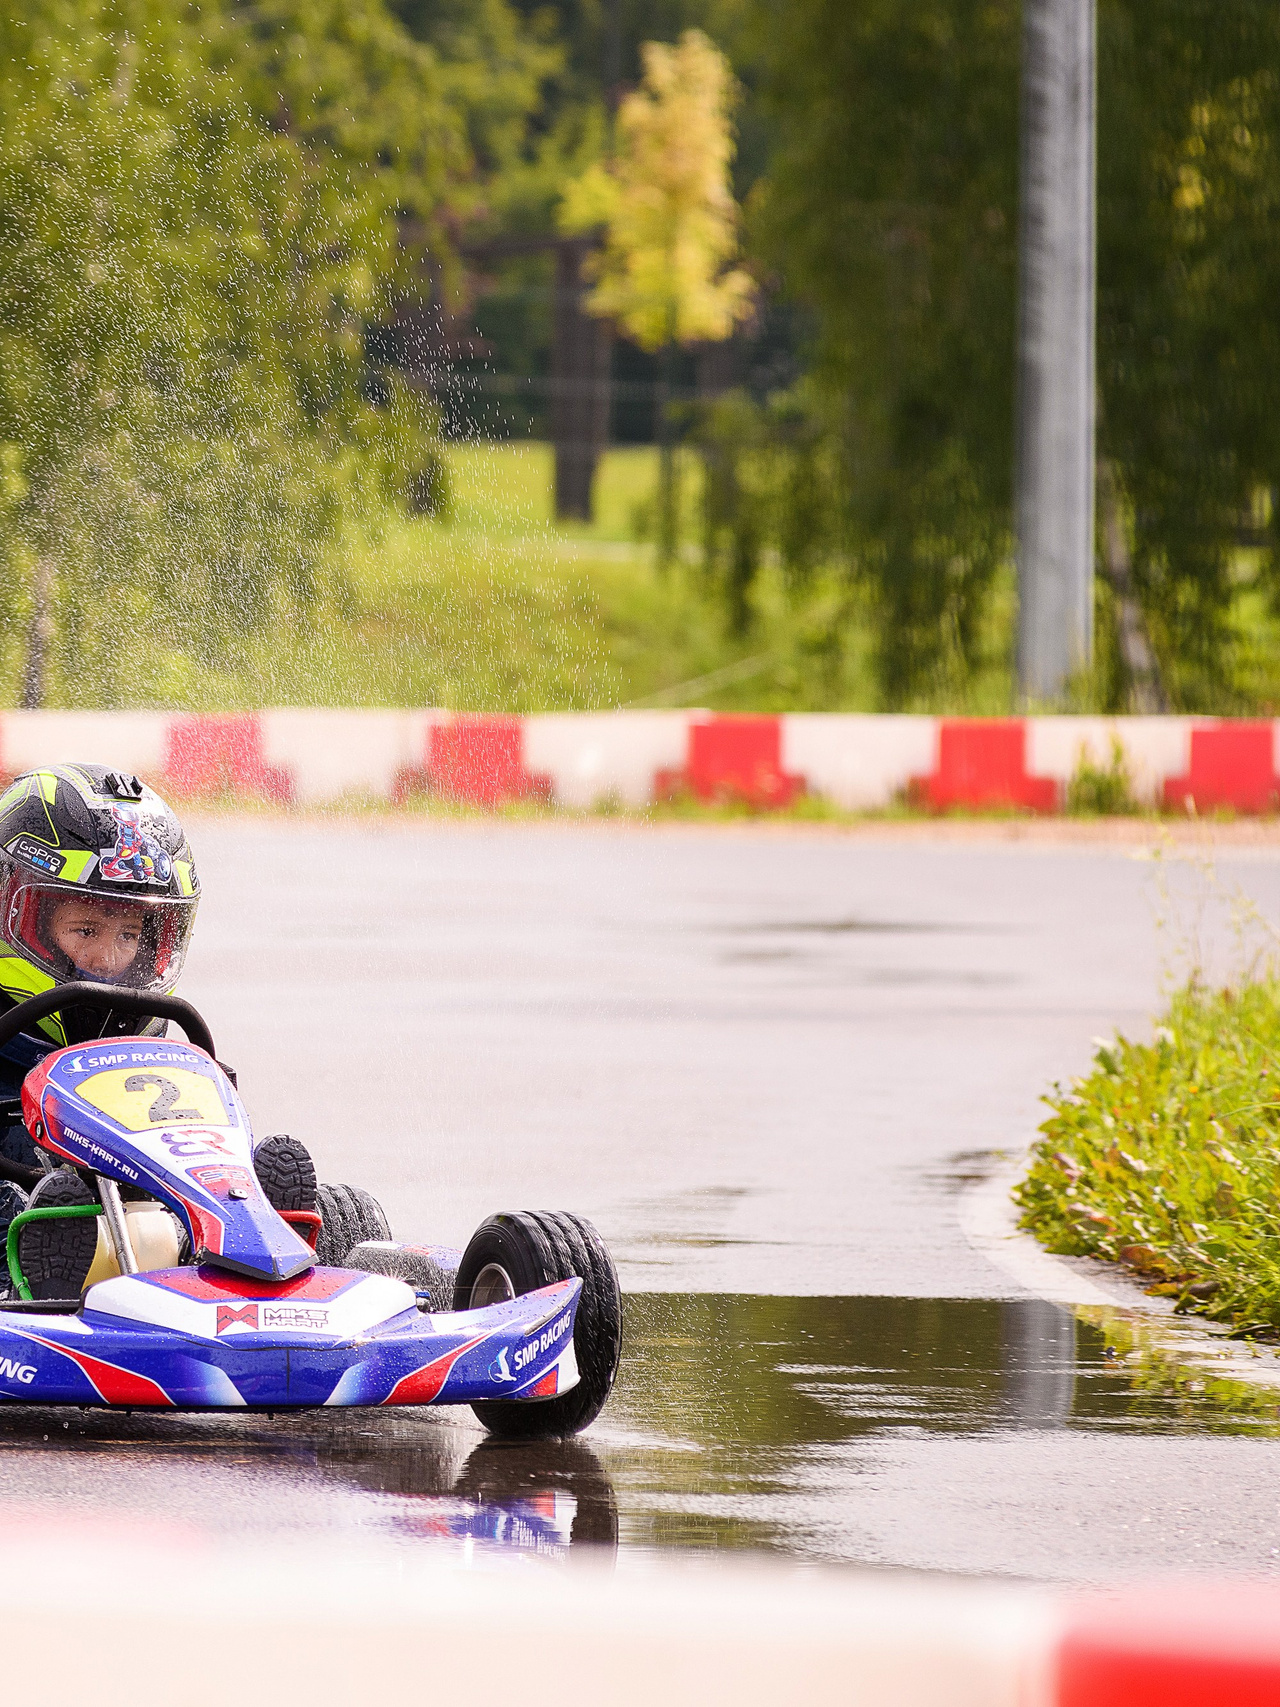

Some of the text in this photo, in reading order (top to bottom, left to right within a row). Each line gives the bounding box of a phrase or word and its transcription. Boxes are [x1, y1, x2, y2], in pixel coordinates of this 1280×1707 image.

[19, 841, 61, 867] GoPro
[88, 1052, 199, 1068] SMP RACING
[124, 1074, 204, 1122] 2
[63, 1126, 139, 1180] MIKS-KART.RU
[264, 1308, 329, 1320] MIKS
[264, 1318, 329, 1328] KART
[514, 1309, 572, 1371] SMP RACING
